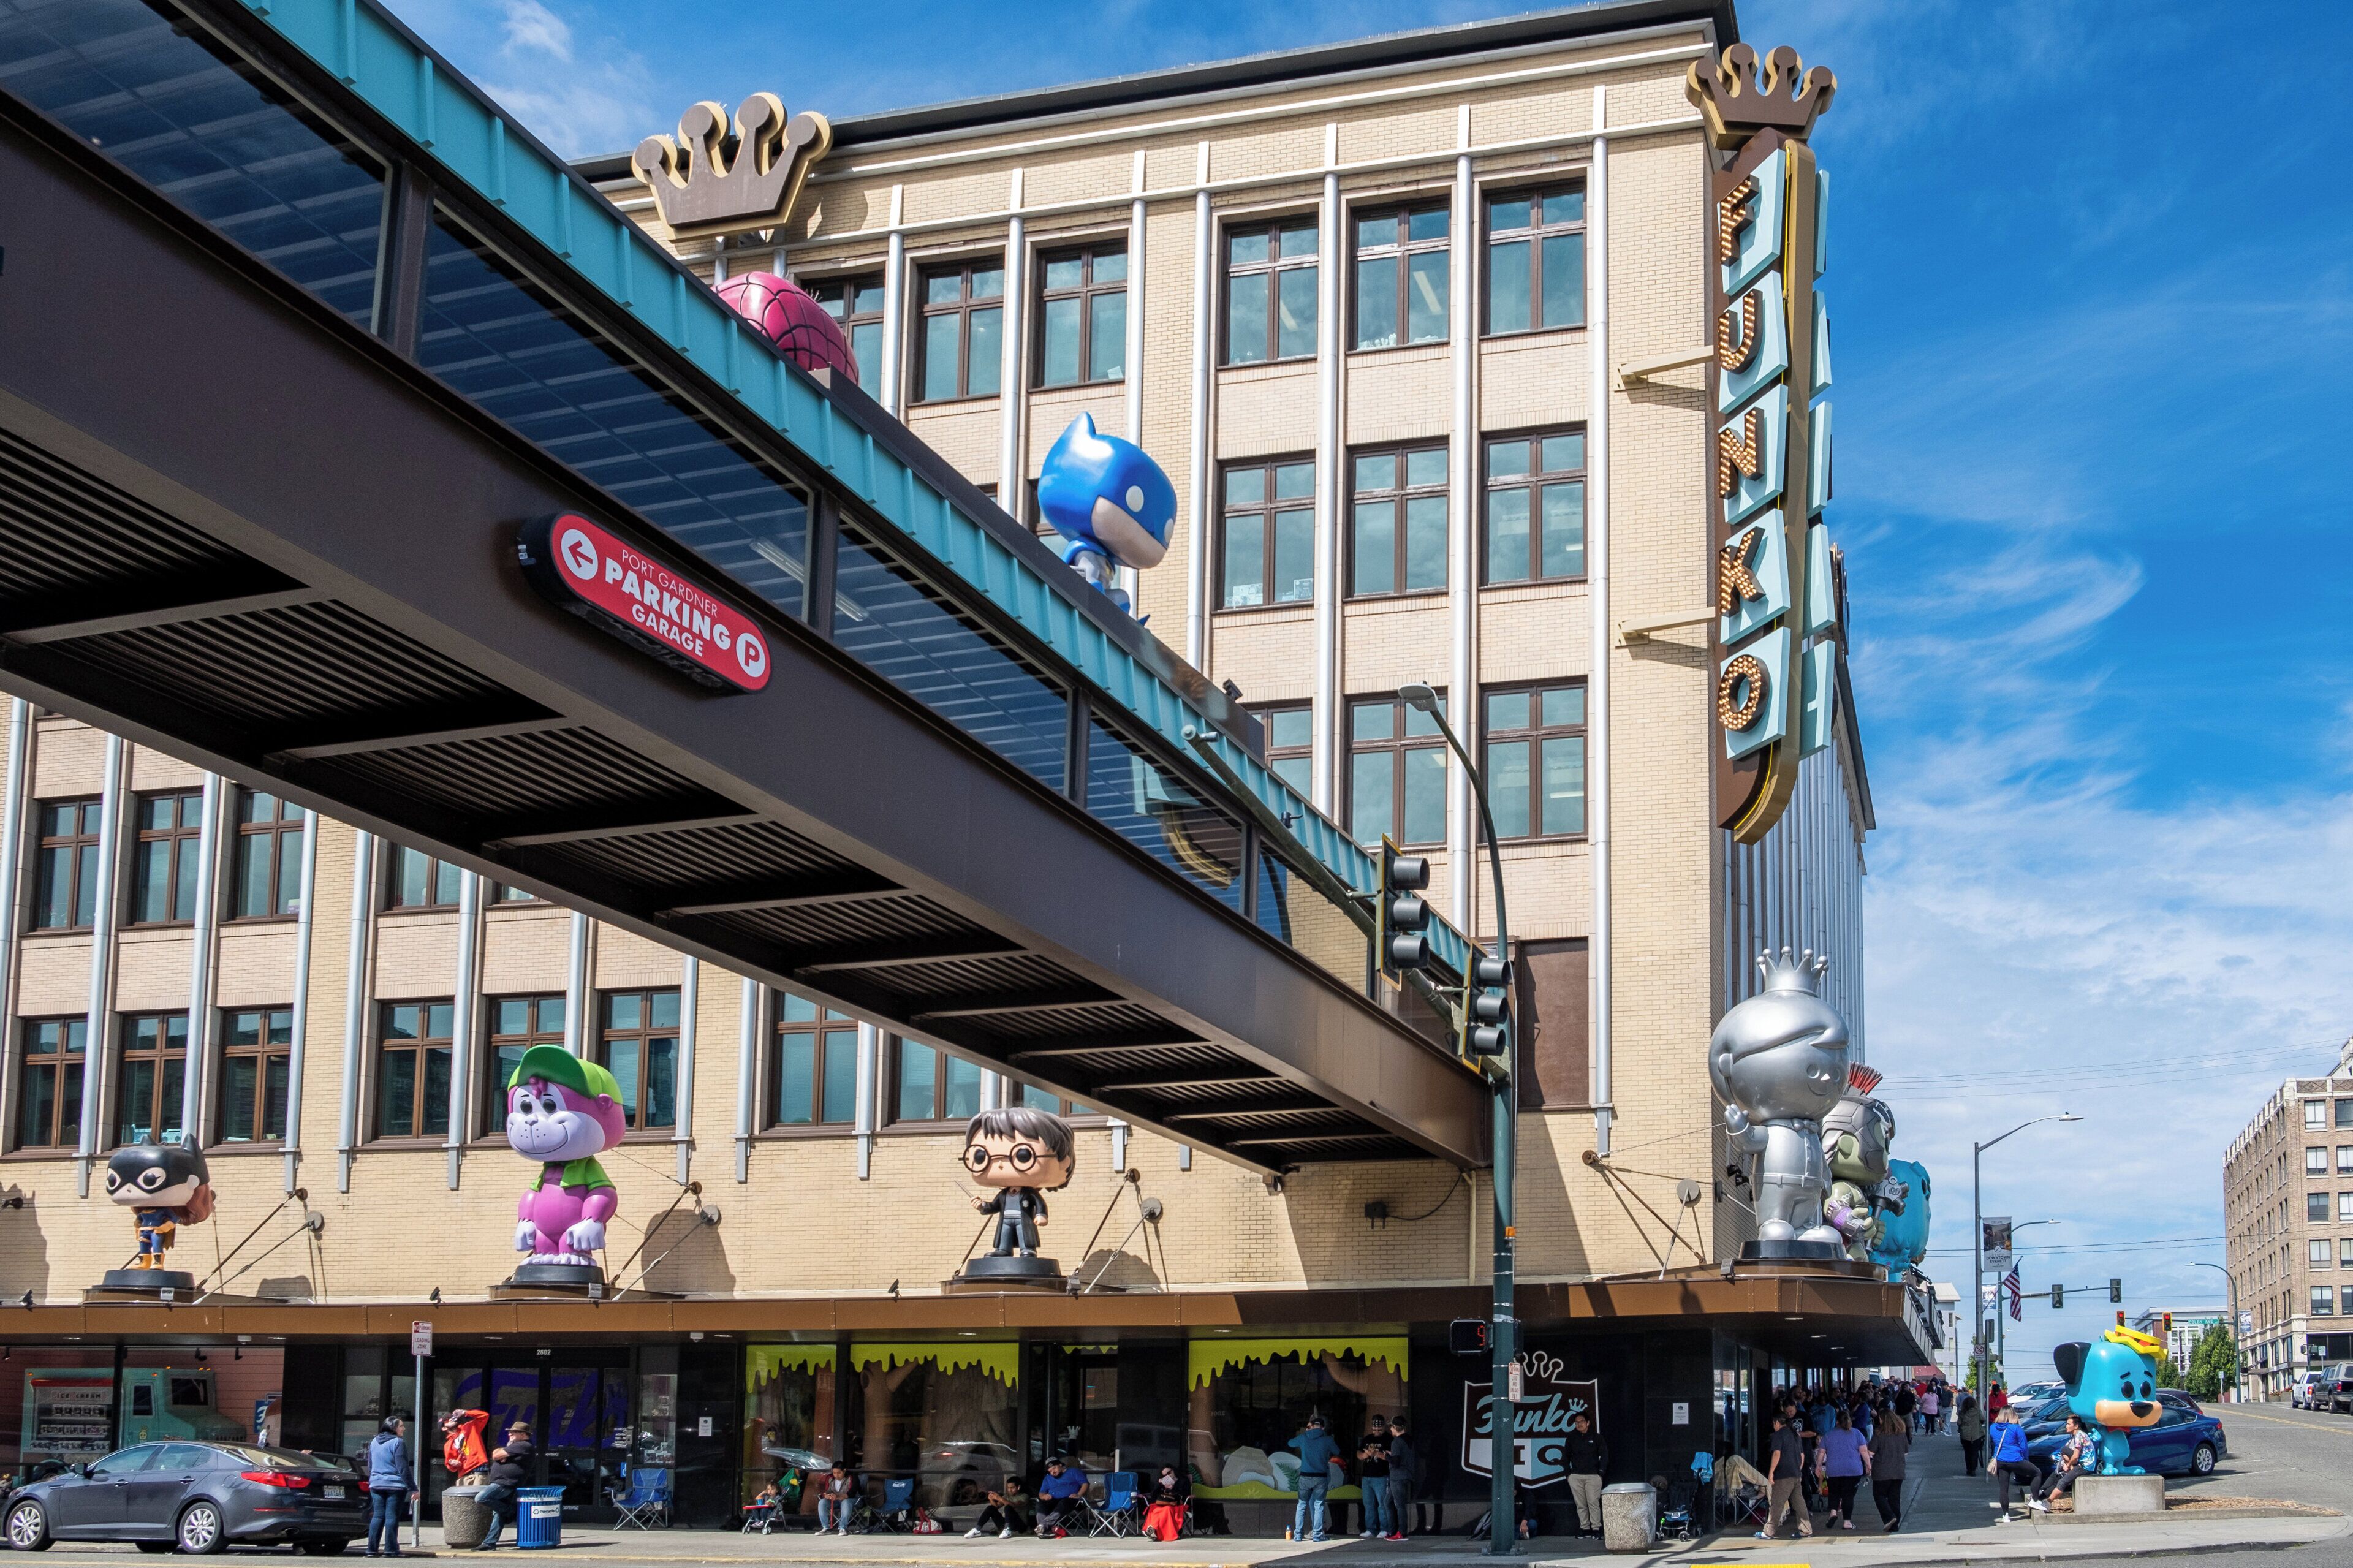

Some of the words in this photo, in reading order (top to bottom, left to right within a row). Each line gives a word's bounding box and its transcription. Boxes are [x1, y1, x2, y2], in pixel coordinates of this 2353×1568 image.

[1717, 174, 1770, 733] FUNKO
[605, 557, 731, 650] PARKING
[622, 549, 654, 578] PORT
[659, 572, 718, 618] GARDNER
[632, 604, 703, 657] GARAGE
[745, 640, 760, 667] P
[1475, 1393, 1577, 1434] Funko
